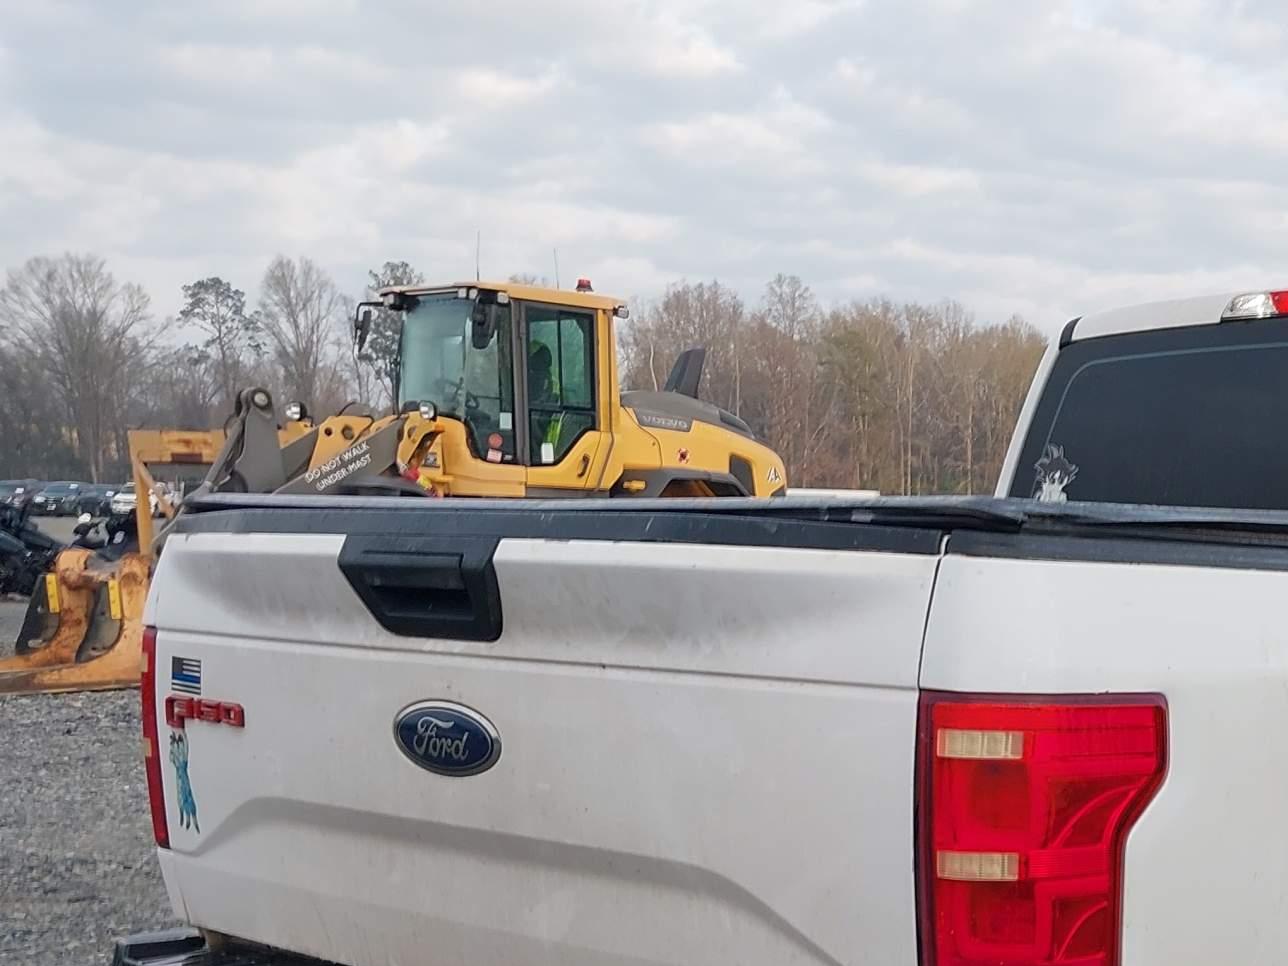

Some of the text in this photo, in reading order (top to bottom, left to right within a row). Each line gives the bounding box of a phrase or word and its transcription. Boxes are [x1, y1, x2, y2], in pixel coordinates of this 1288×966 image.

[642, 415, 688, 428] VOLVO
[304, 440, 370, 483] DO NOT WALK
[316, 453, 372, 491] UNDER MAST
[414, 716, 469, 760] Ford
